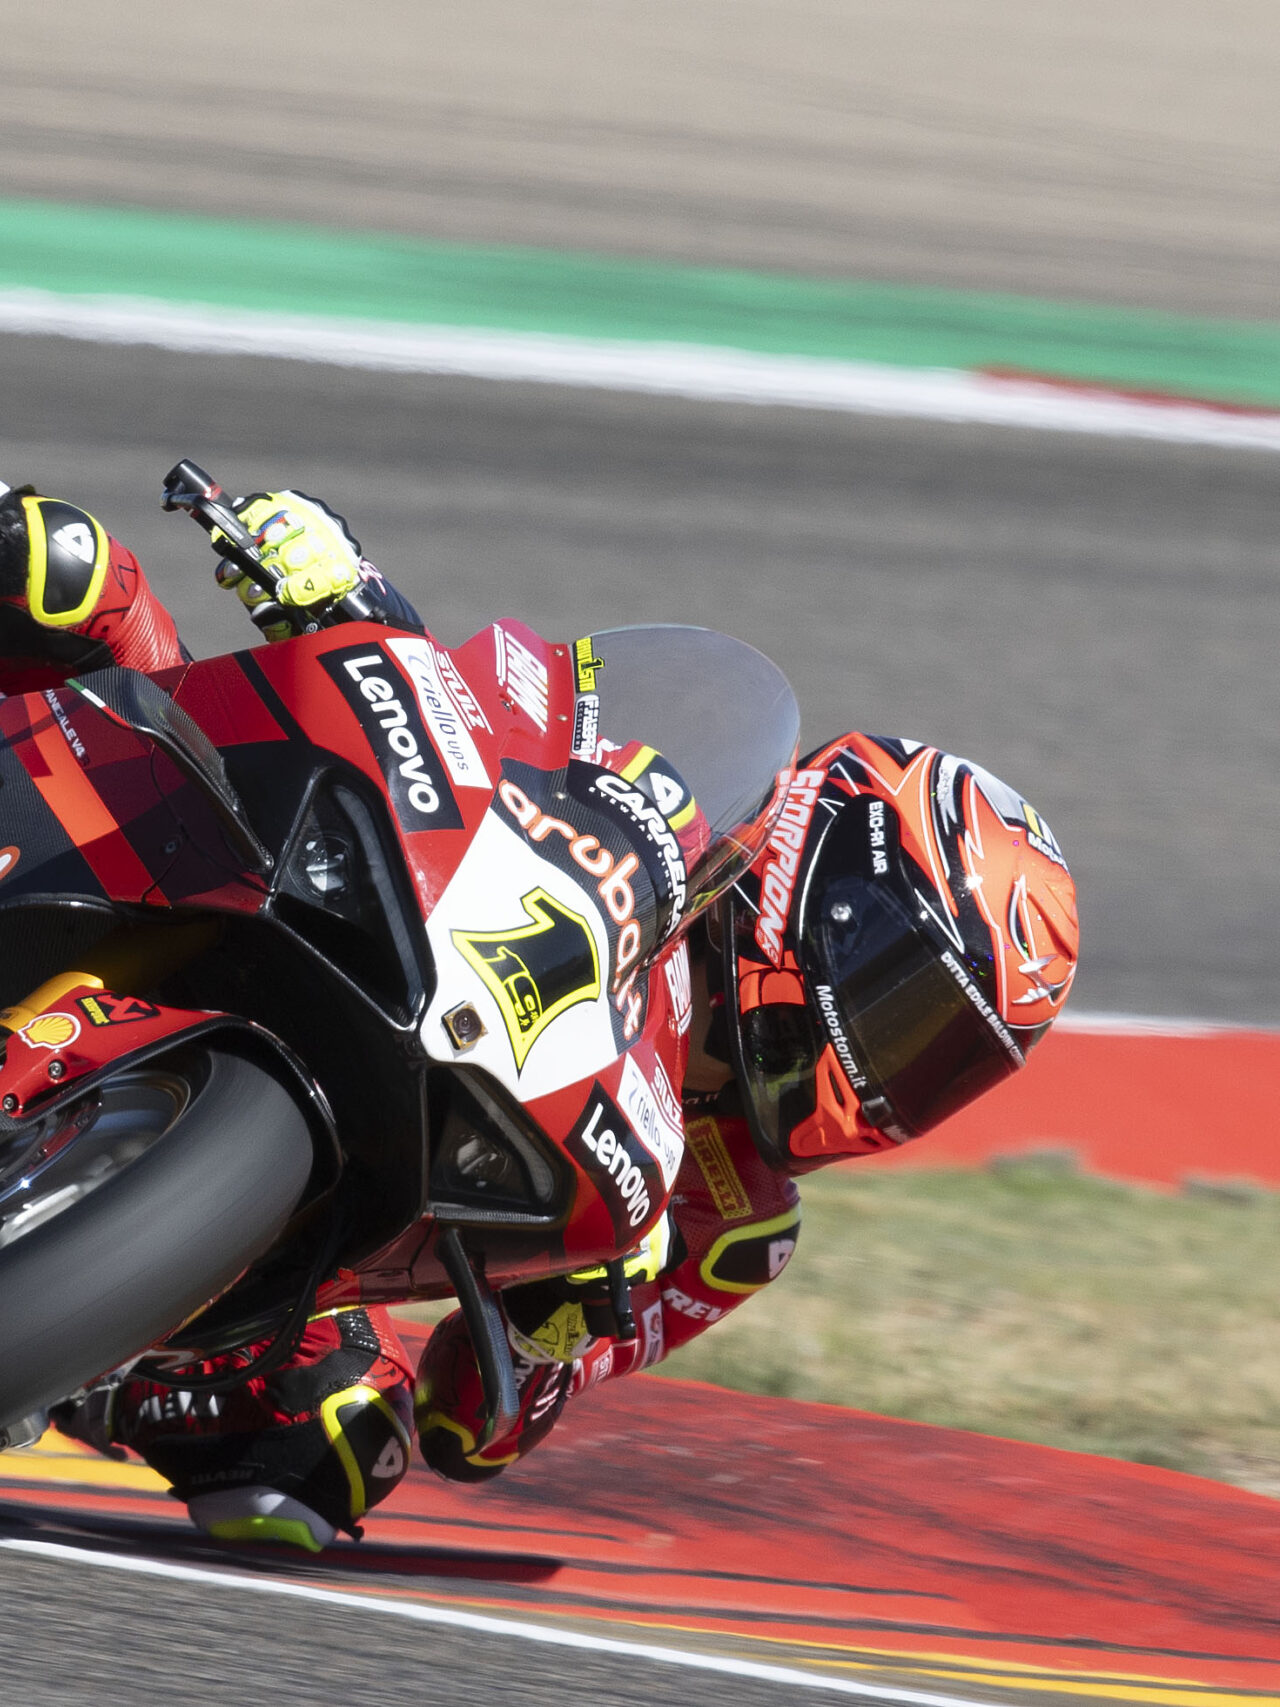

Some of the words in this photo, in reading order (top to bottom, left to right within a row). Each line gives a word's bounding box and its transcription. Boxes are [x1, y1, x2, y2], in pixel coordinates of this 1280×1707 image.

[70, 736, 88, 758] V4
[343, 654, 441, 814] Lenovo
[435, 650, 483, 731] STULZ
[447, 738, 470, 772] ups
[500, 779, 643, 1040] aruba.it
[594, 773, 688, 938] CARRERA
[757, 769, 826, 946] SCORPION
[871, 848, 890, 876] AIR
[451, 886, 601, 1077] 1
[815, 984, 868, 1090] Motostorm.it
[653, 1066, 683, 1129] STULZ
[581, 1102, 651, 1228] Lenovo
